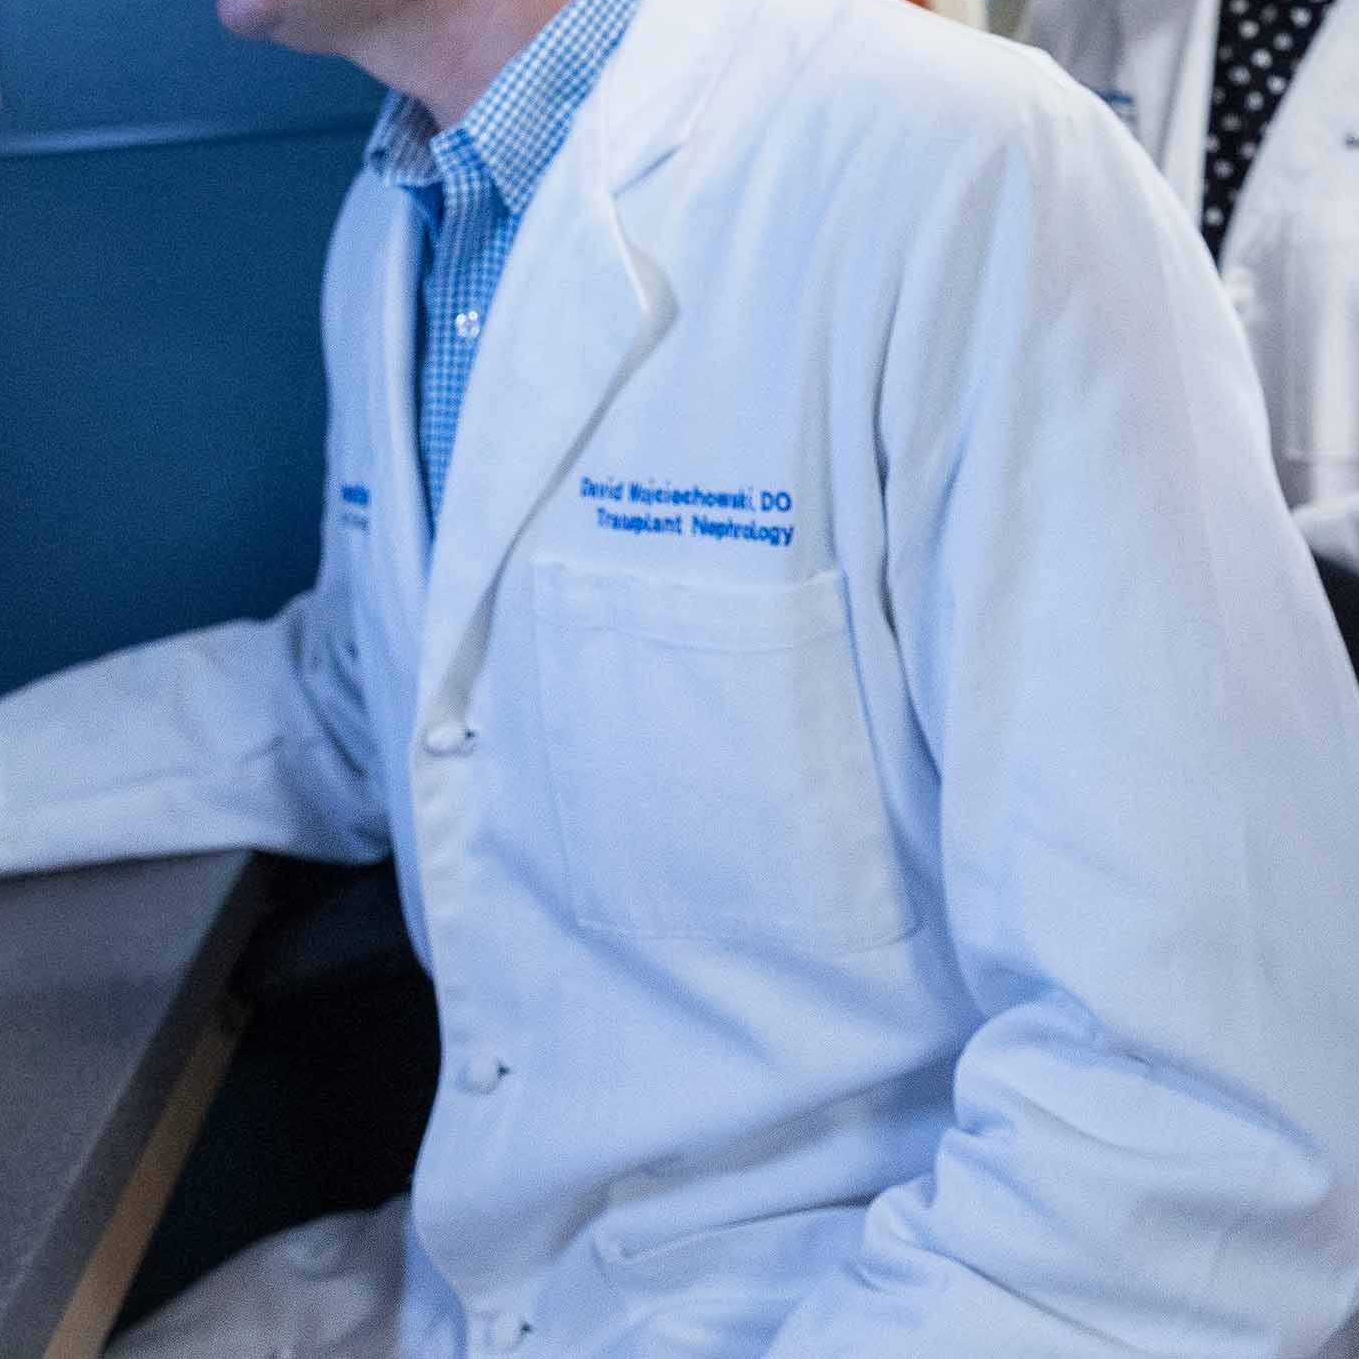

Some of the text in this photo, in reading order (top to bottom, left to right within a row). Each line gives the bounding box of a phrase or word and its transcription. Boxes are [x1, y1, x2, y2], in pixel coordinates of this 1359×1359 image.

[759, 491, 791, 512] DO
[596, 507, 794, 546] Transplant Nephrology
